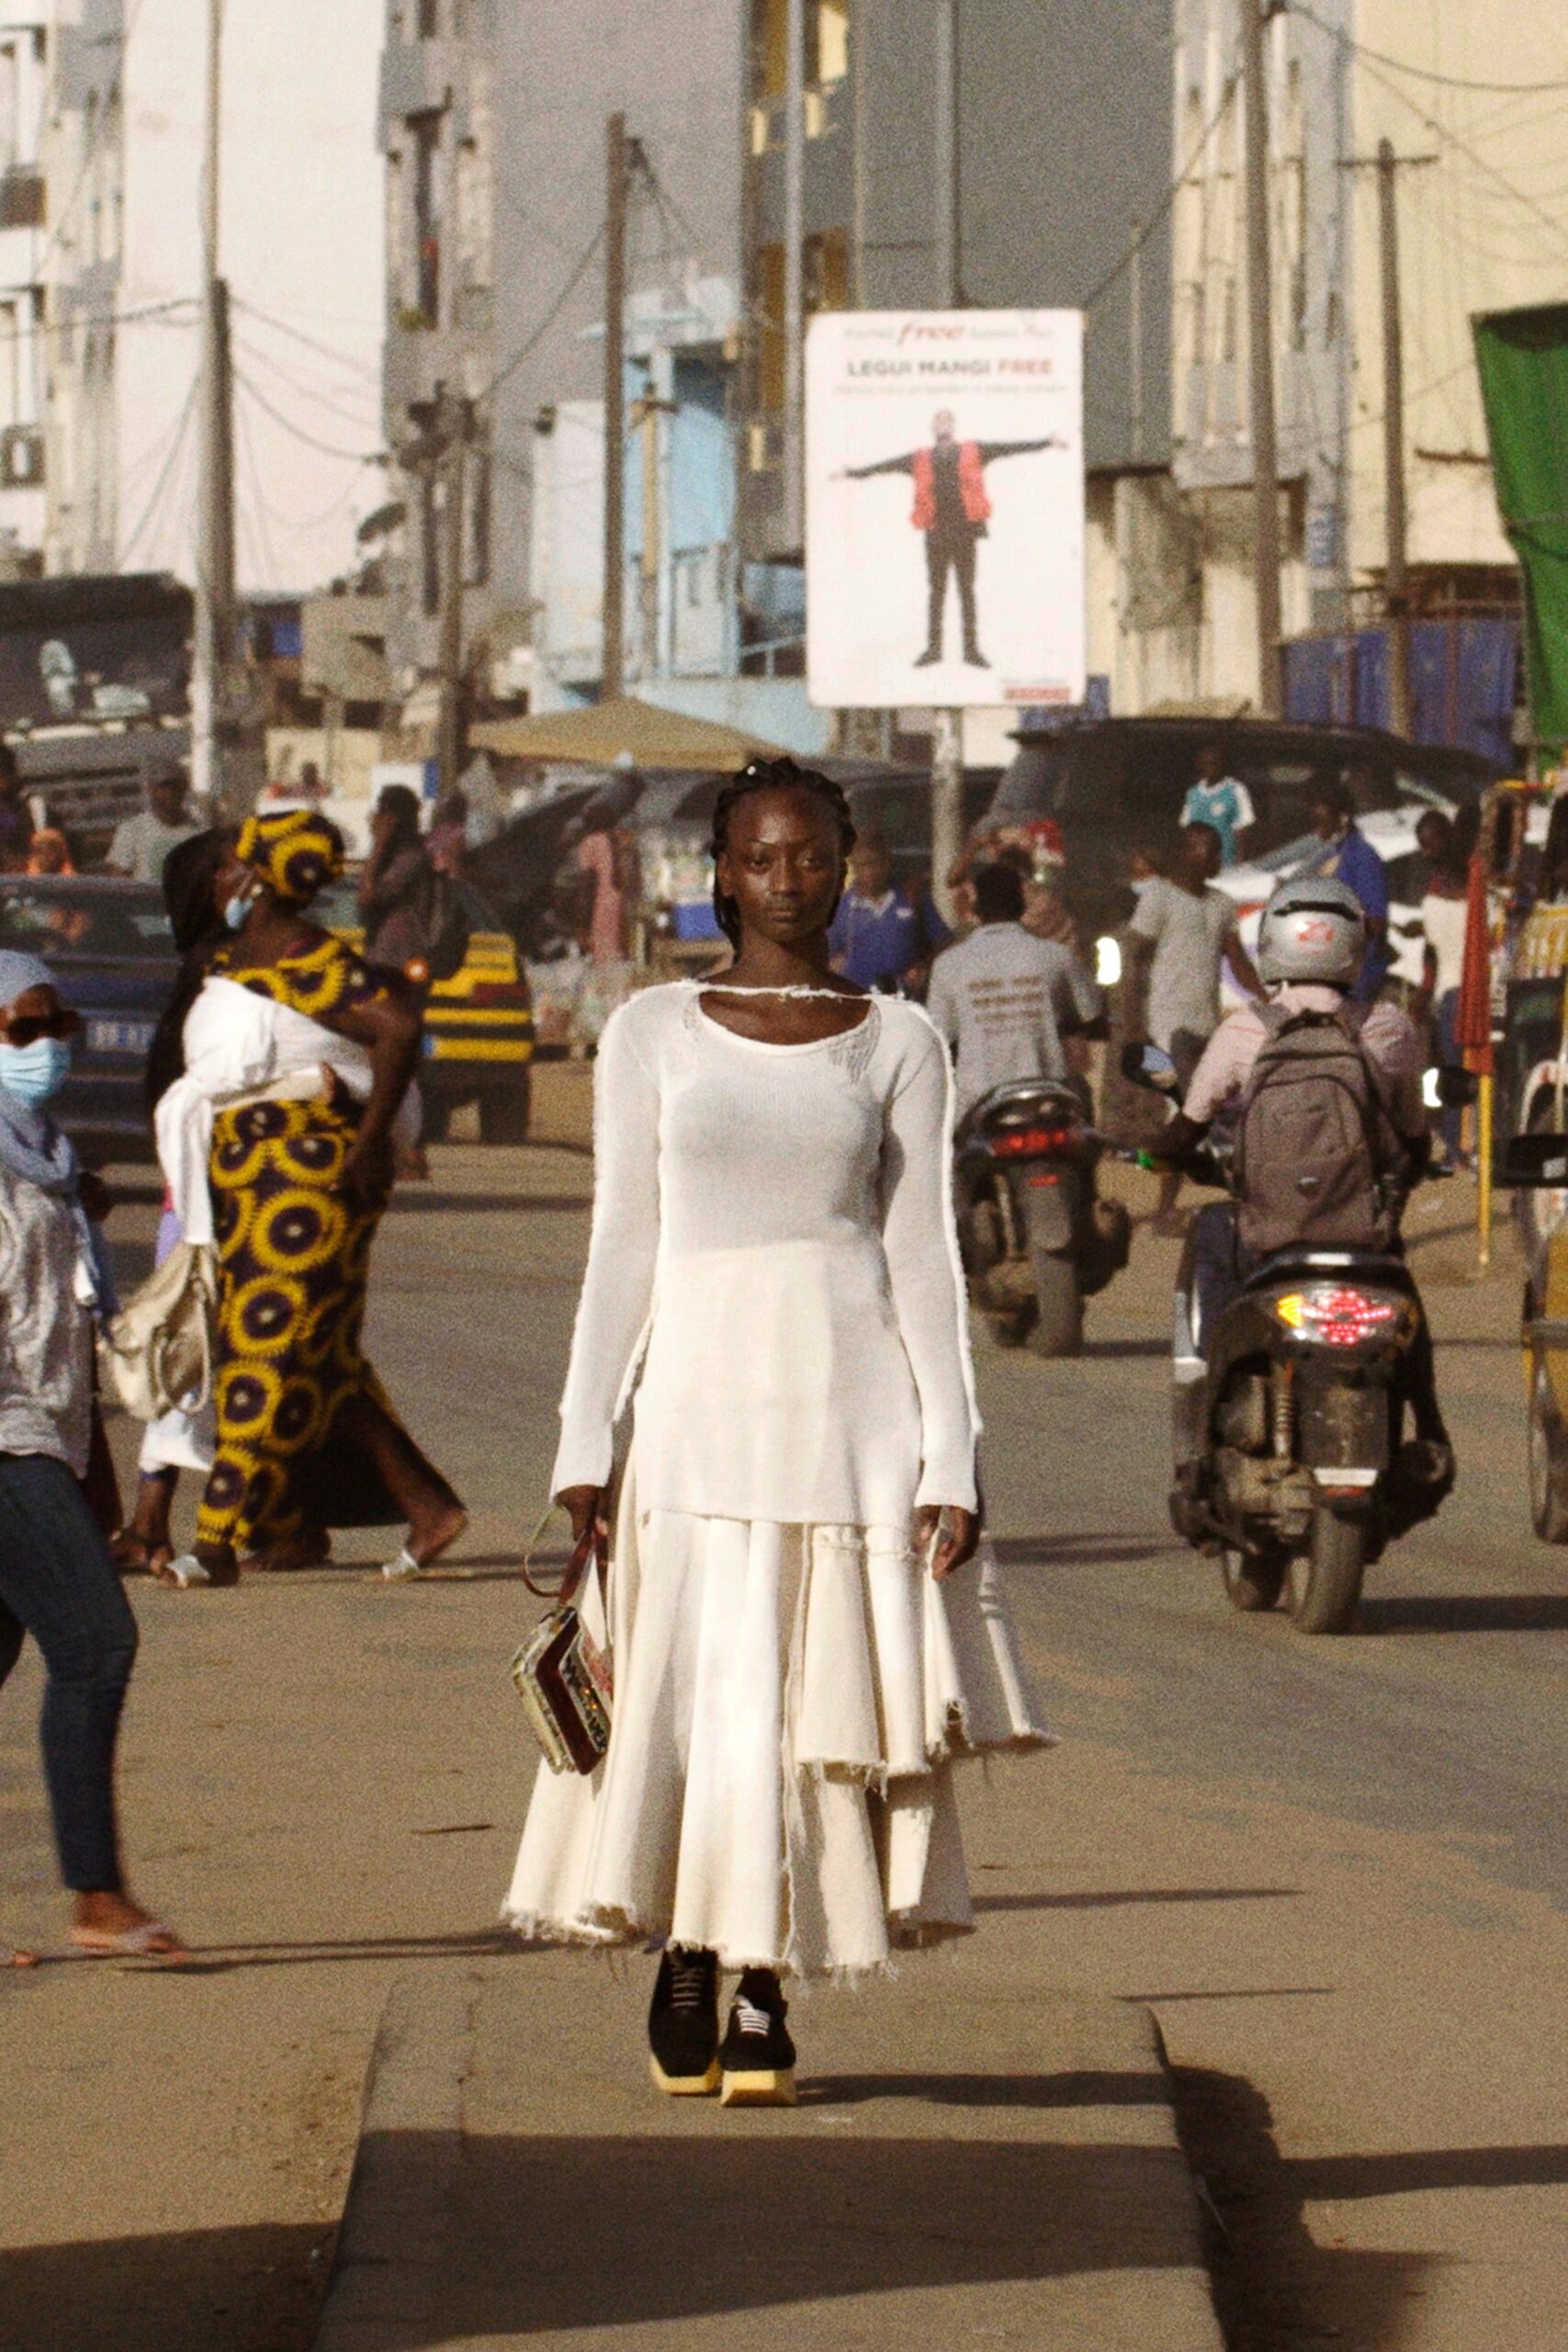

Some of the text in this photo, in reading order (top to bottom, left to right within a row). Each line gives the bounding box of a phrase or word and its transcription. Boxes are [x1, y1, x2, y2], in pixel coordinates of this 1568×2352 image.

[847, 357, 1052, 377] LEGUI MANGI FREE
